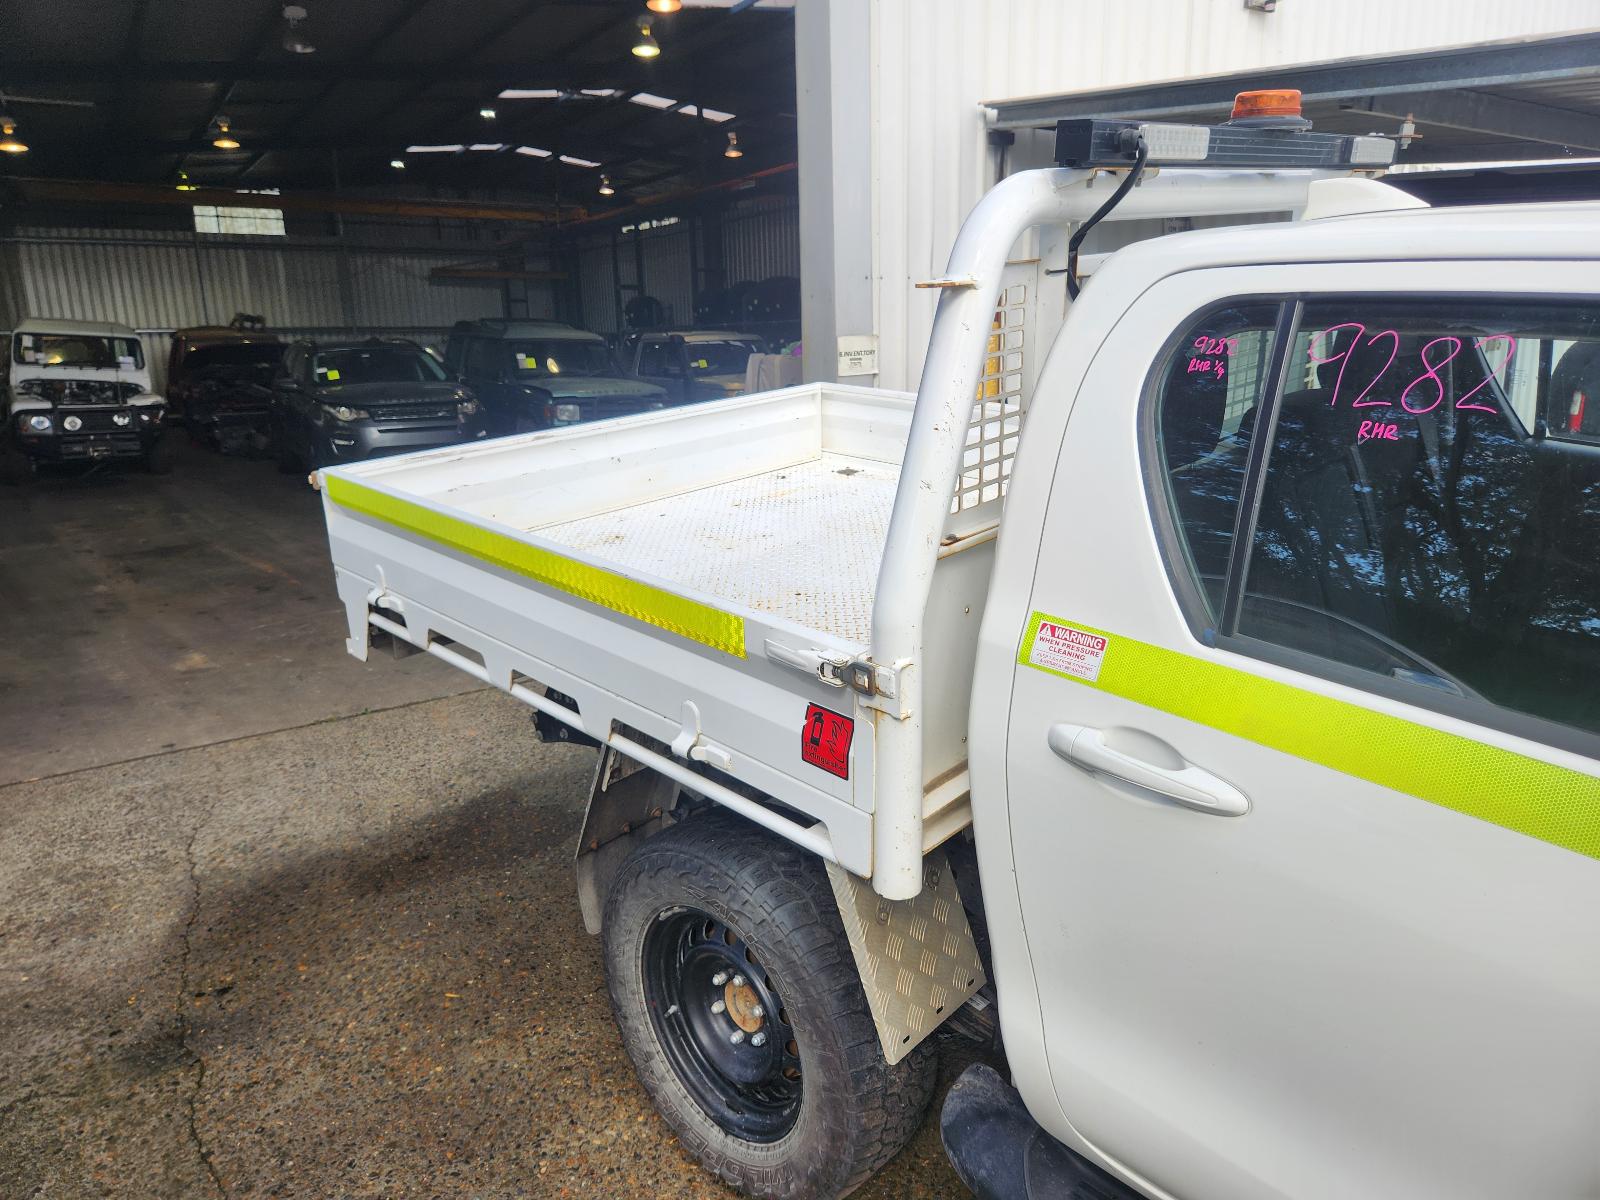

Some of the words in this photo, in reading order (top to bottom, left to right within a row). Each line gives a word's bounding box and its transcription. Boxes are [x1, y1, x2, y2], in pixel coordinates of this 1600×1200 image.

[1194, 336, 1238, 356] 9282
[1187, 357, 1211, 373] RHR
[1307, 322, 1517, 414] 9282
[1357, 420, 1399, 443] RHR
[1039, 635, 1060, 647] WHEN
[1061, 642, 1100, 658] PRESSURE
[1053, 626, 1103, 650] WARNING
[1048, 645, 1086, 661] CLEANING
